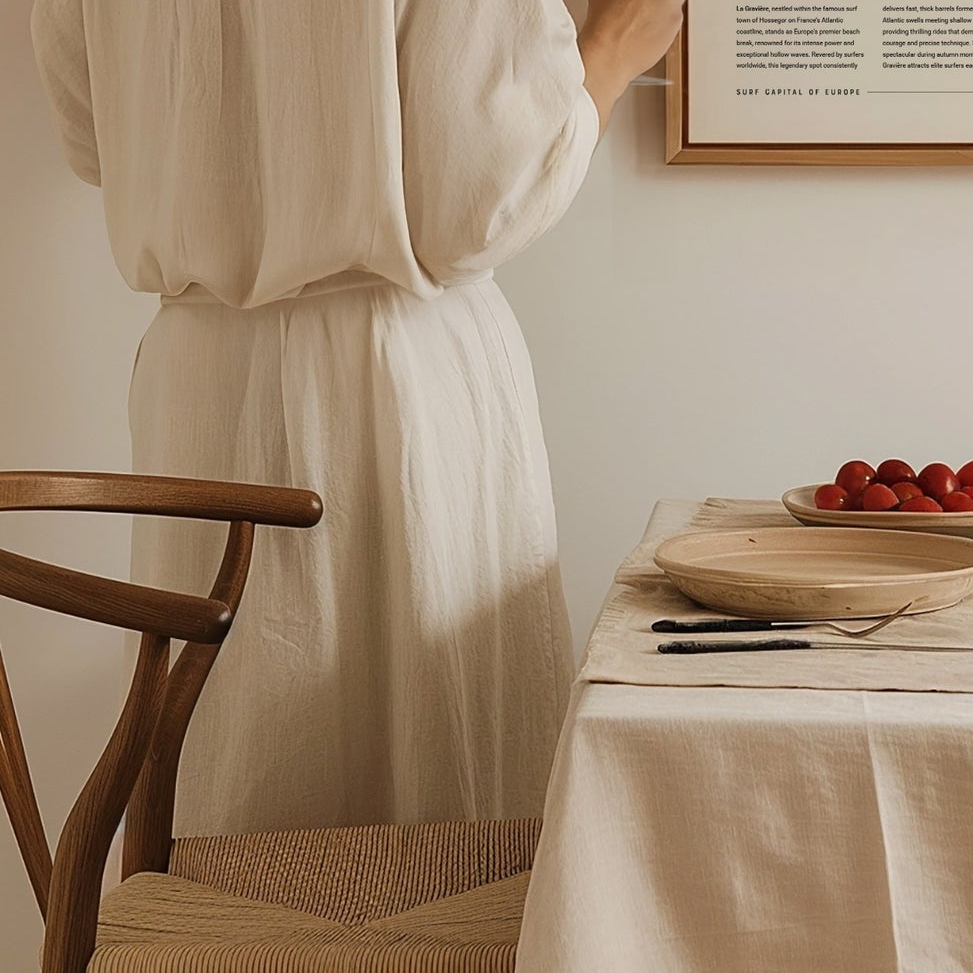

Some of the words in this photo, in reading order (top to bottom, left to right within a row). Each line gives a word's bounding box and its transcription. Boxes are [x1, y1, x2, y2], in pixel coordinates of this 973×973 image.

[744, 6, 771, 14] Gravière,
[905, 6, 919, 14] fast,
[759, 17, 787, 25] Hossegor
[924, 17, 949, 25] meeting
[736, 28, 764, 36] coastline,
[819, 28, 841, 36] premier
[882, 28, 909, 36] providing
[910, 28, 932, 36] thrilling
[736, 51, 769, 59] exceptional
[836, 51, 843, 59] by
[882, 51, 916, 59] spectacular
[917, 51, 936, 59] during
[736, 62, 767, 70] worldwide,
[780, 62, 808, 70] legendary
[809, 62, 822, 70] spot
[823, 62, 858, 70] consistently
